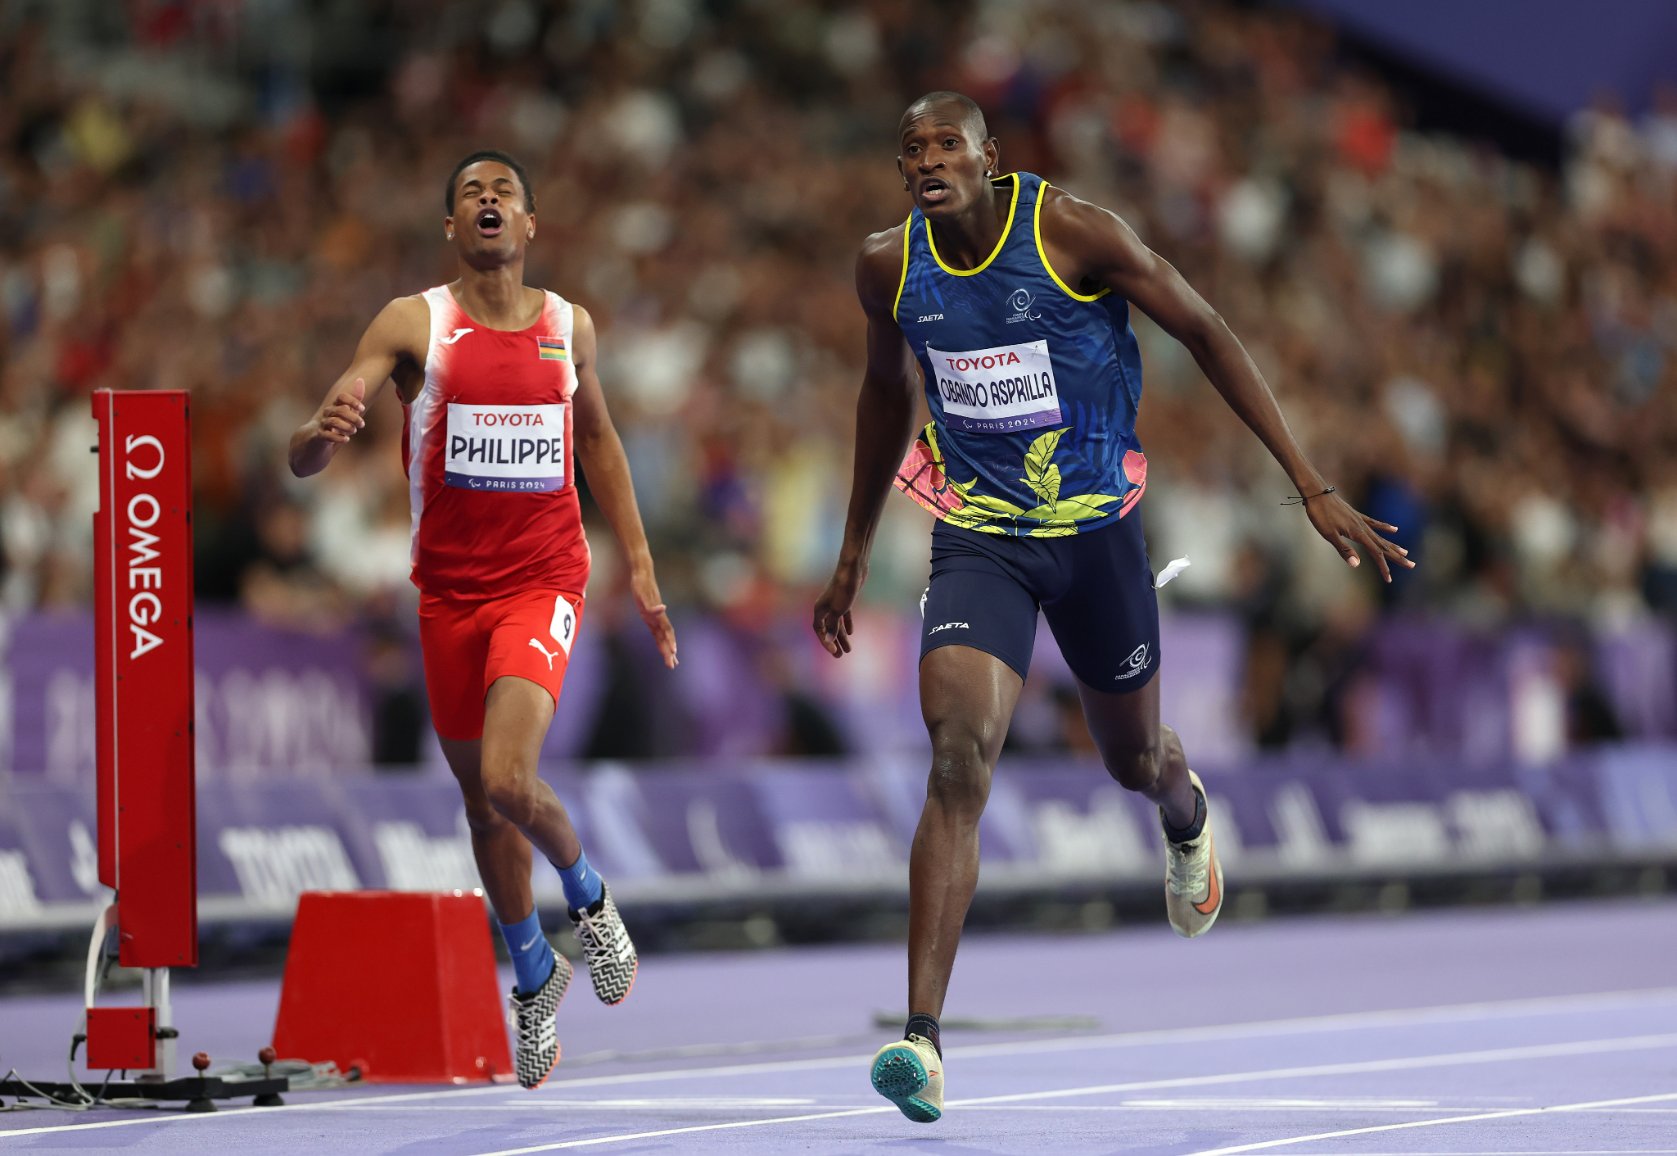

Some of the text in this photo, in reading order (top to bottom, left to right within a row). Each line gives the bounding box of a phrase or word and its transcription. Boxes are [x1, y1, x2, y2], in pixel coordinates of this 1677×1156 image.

[917, 313, 944, 323] SAETA
[946, 352, 1020, 371] TOYOTA
[940, 371, 1053, 408] OBANDO ASPRILLA
[472, 413, 544, 426] TOYOTA
[977, 418, 1036, 430] PARIS 2024
[451, 435, 561, 464] PHILIPPE
[486, 480, 545, 490] PARIS 2024
[127, 493, 164, 660] OMEGA
[563, 613, 572, 640] 9
[928, 622, 970, 636] SAETA
